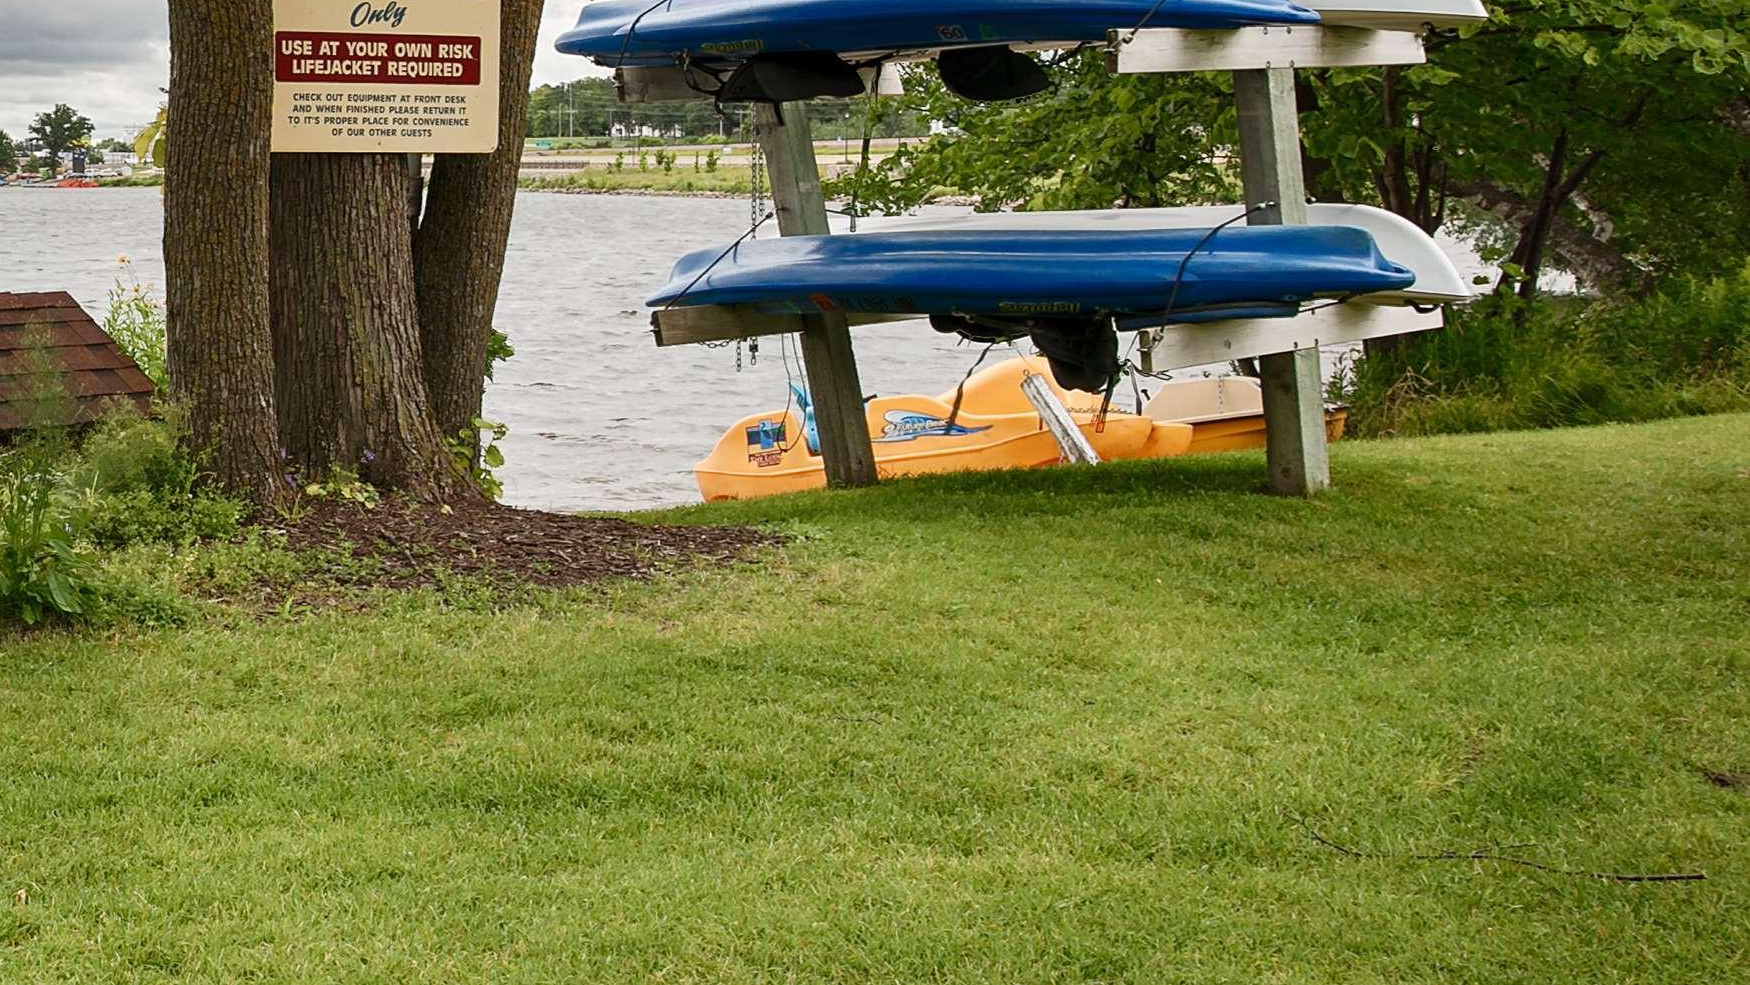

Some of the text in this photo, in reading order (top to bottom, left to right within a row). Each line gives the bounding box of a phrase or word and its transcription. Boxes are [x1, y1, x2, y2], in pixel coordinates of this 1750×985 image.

[350, 0, 408, 28] Only
[281, 40, 474, 59] USE AT YOUR OWN RISK
[292, 59, 463, 78] LIFEJACKET REQUIRED
[293, 93, 466, 104] CHECK OUT EQUIPMENT AT FRONT DESK
[293, 104, 467, 115] AND WHEN FINISHED PLEASE RETURN IT
[288, 116, 470, 126] TO IT'S PROPER PLACE FOR CONVENIENCE
[331, 128, 433, 137] OF OUR OTHER GUESTS
